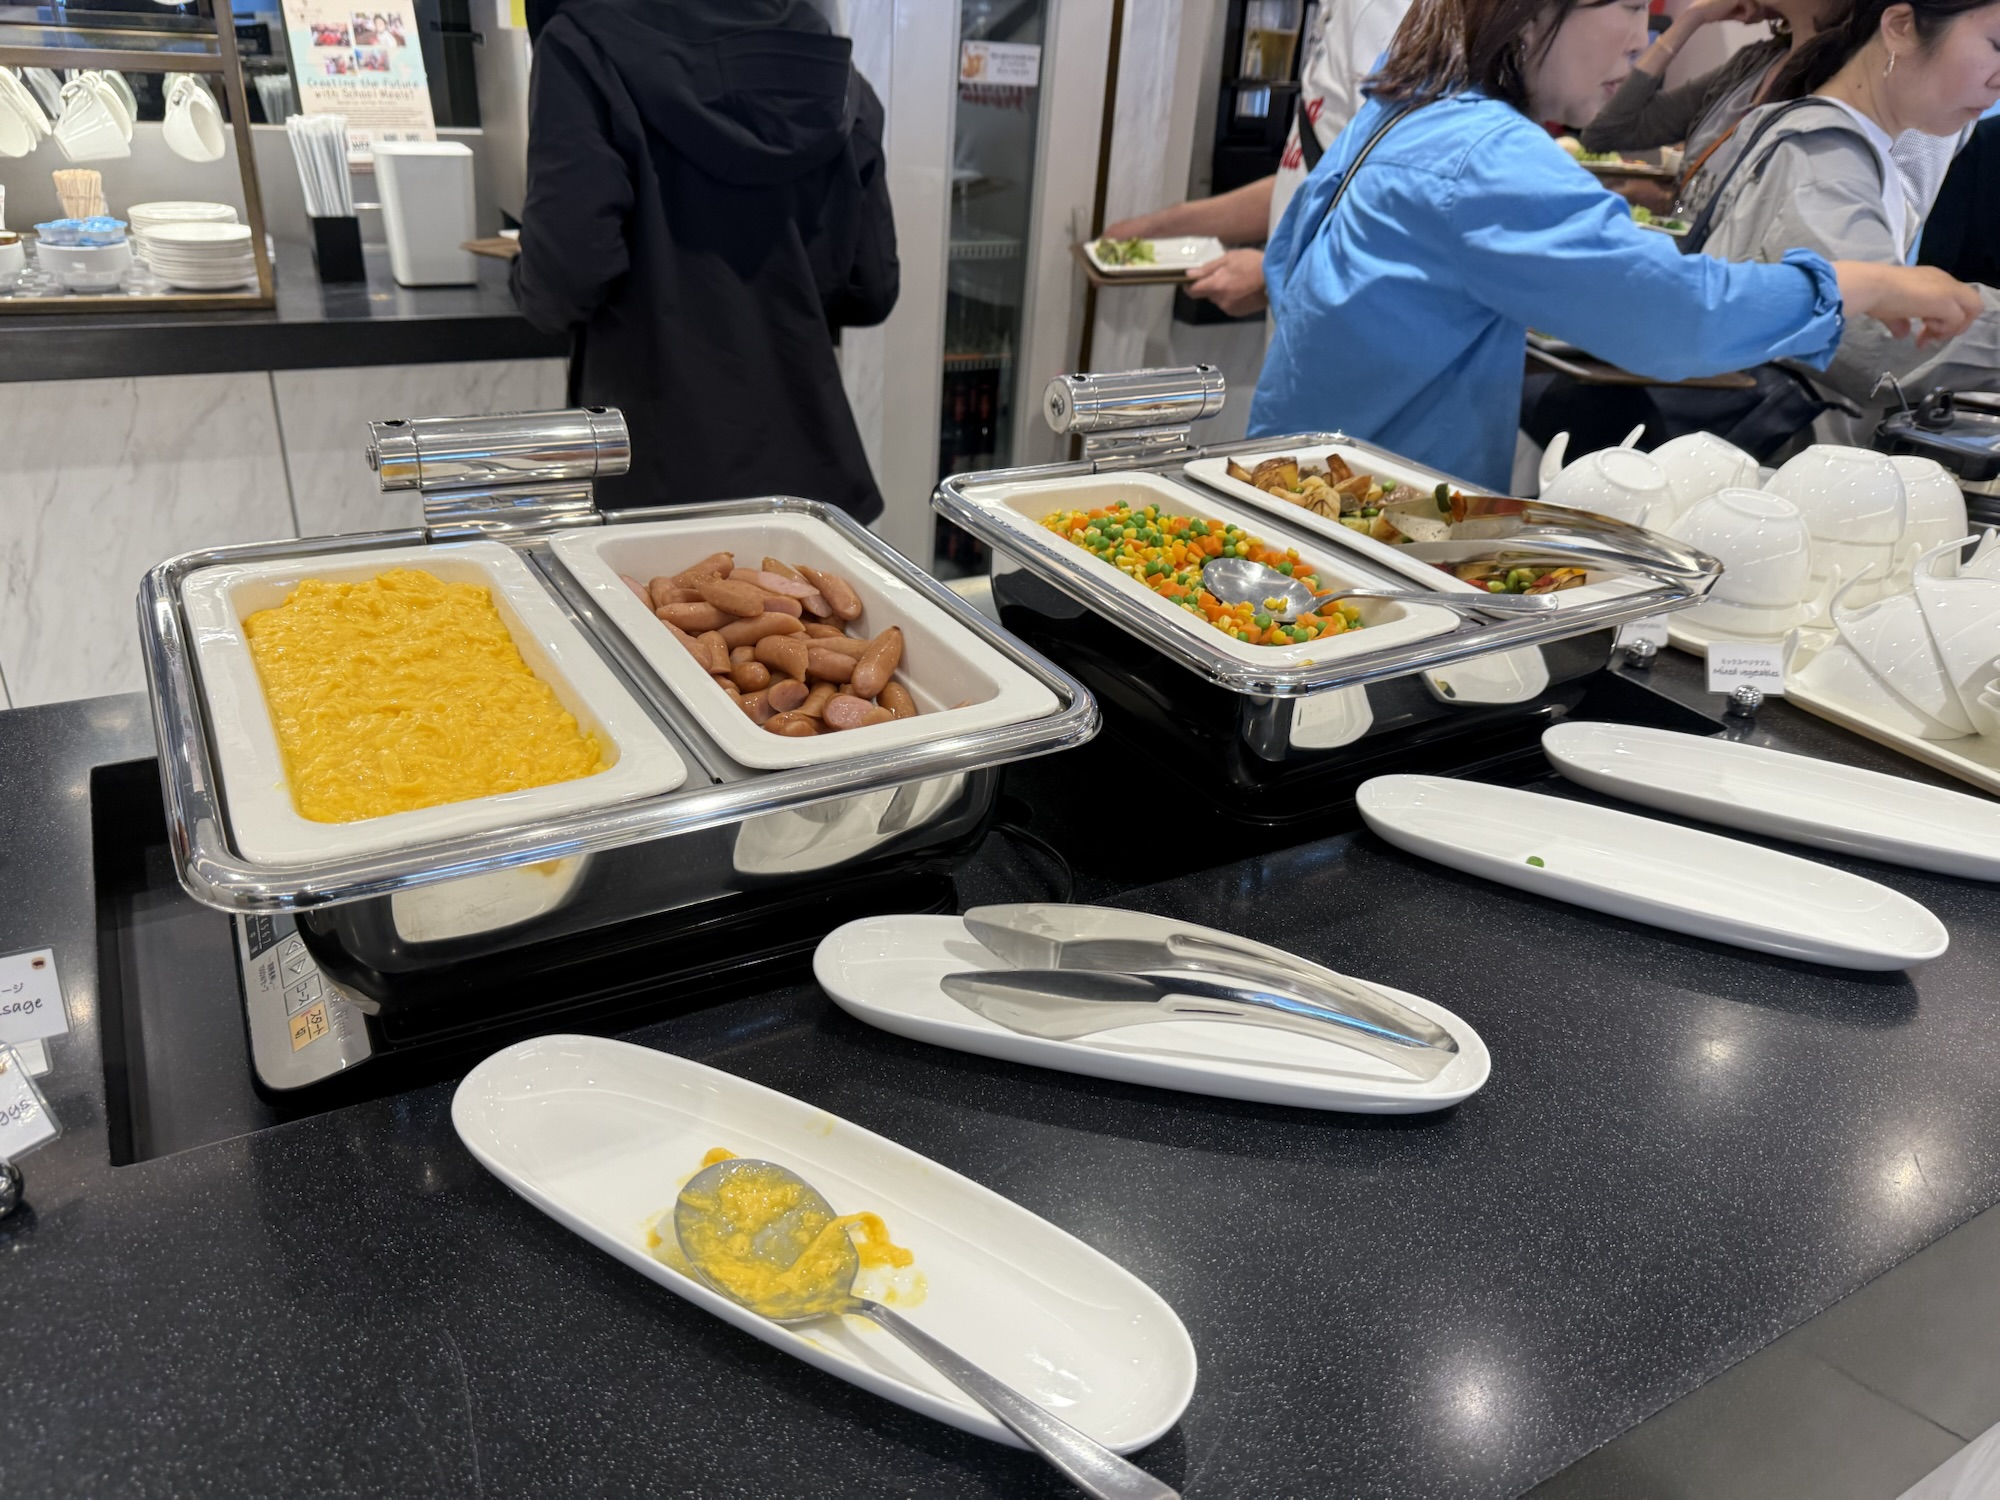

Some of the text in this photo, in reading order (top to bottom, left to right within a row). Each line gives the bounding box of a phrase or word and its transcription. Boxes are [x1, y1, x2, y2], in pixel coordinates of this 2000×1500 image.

[307, 77, 419, 89] Creating the Future
[315, 88, 339, 99] with
[342, 88, 377, 98] School
[297, 982, 310, 1006] コース
[0, 998, 43, 1016] sage
[310, 1009, 325, 1036] スタート
